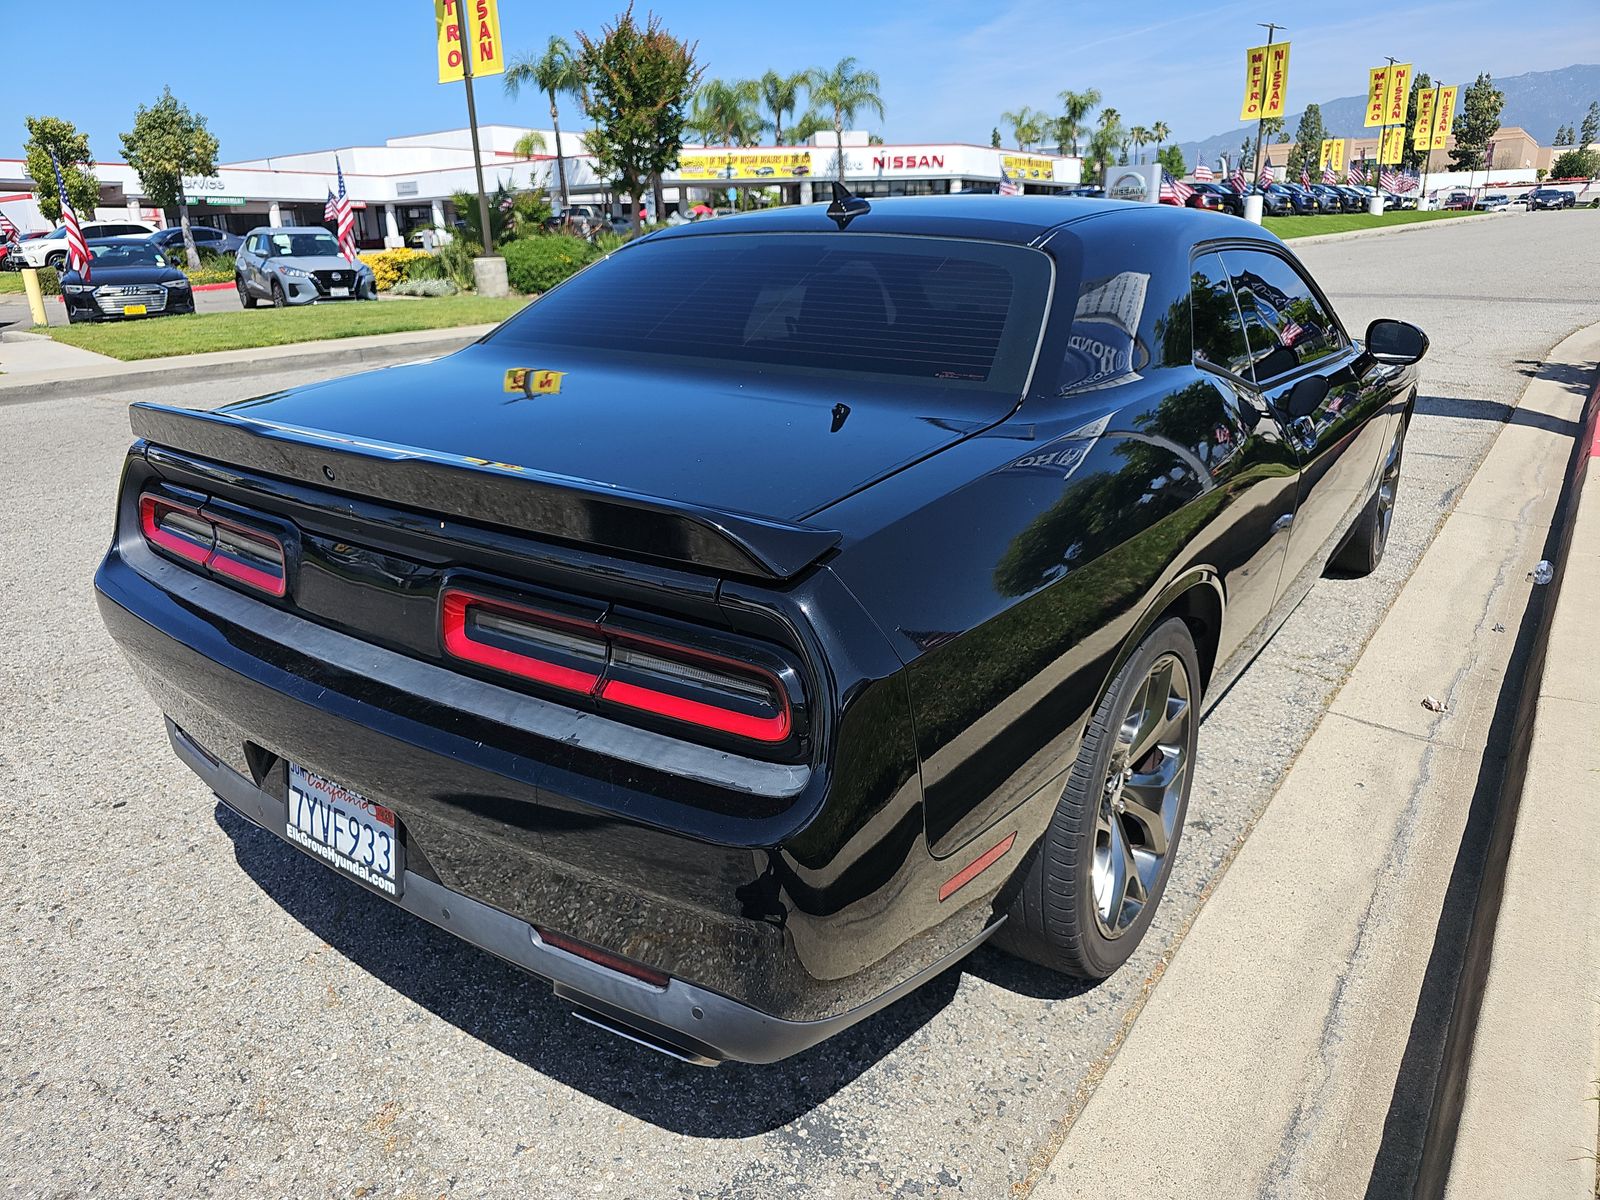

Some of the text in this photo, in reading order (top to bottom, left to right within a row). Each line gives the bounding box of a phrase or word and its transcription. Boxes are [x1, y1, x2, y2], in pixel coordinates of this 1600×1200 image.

[477, 0, 493, 61] SAN
[1248, 53, 1263, 113] METRO
[1269, 50, 1284, 111] NISSAN
[1370, 72, 1385, 121] METRO
[1391, 69, 1405, 119] NISSAN
[1418, 92, 1432, 134] METRO
[1438, 91, 1452, 132] NISSAN
[740, 155, 758, 164] NISSAN
[873, 155, 944, 170] NISSAN
[182, 175, 225, 190] ervice
[1110, 186, 1145, 197] NISSAN
[307, 771, 369, 811] California
[292, 785, 391, 874] 7YVF933
[286, 823, 396, 895] ElkGroveHyundai.com
